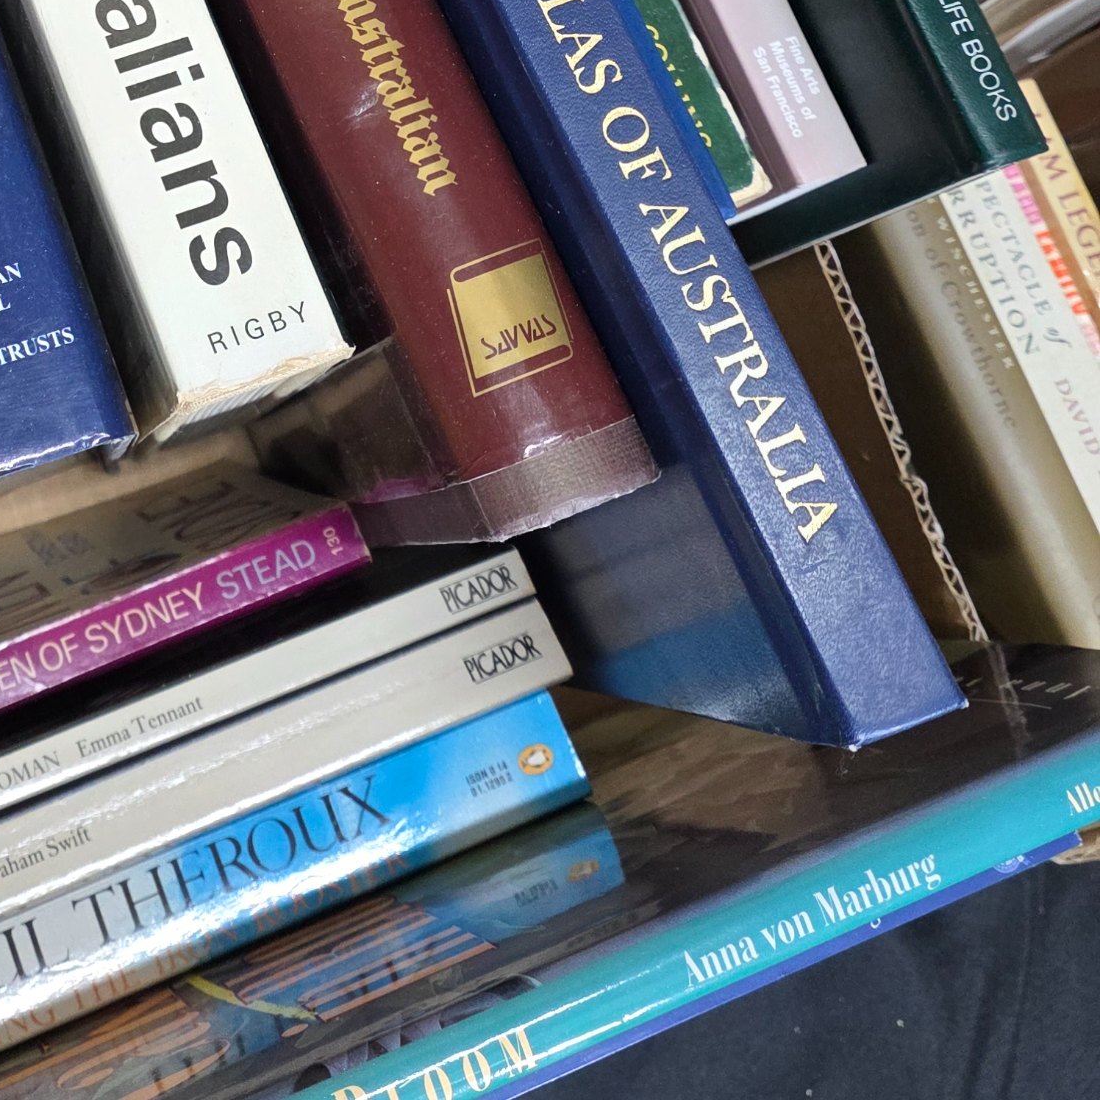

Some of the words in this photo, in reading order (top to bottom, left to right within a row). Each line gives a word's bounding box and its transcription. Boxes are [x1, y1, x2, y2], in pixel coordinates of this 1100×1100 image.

[753, 46, 772, 74] San
[766, 74, 803, 138] Francisco
[768, 40, 807, 106] Museums
[785, 35, 806, 67] Fine
[800, 67, 821, 95] Arts
[961, 39, 1018, 122] BOOKS
[948, 189, 1040, 356] RRUPTION
[975, 180, 1054, 317] PECTACLE
[206, 303, 308, 356] RIGBY
[600, 107, 674, 182] OF
[638, 202, 838, 543] AUSTRALIA
[321, 527, 341, 556] 130
[39, 635, 81, 672] OF
[86, 582, 204, 655] SYDNEY
[215, 538, 317, 601] STEAD
[440, 565, 519, 613] PICADOR
[463, 634, 543, 683] PICADOR
[77, 727, 132, 758] Emma
[131, 696, 204, 737] Tennant
[45, 827, 94, 857] Swift
[72, 775, 395, 946] THEROUX
[682, 934, 760, 989] Anna
[759, 908, 816, 952] von
[812, 853, 942, 928] Marburg
